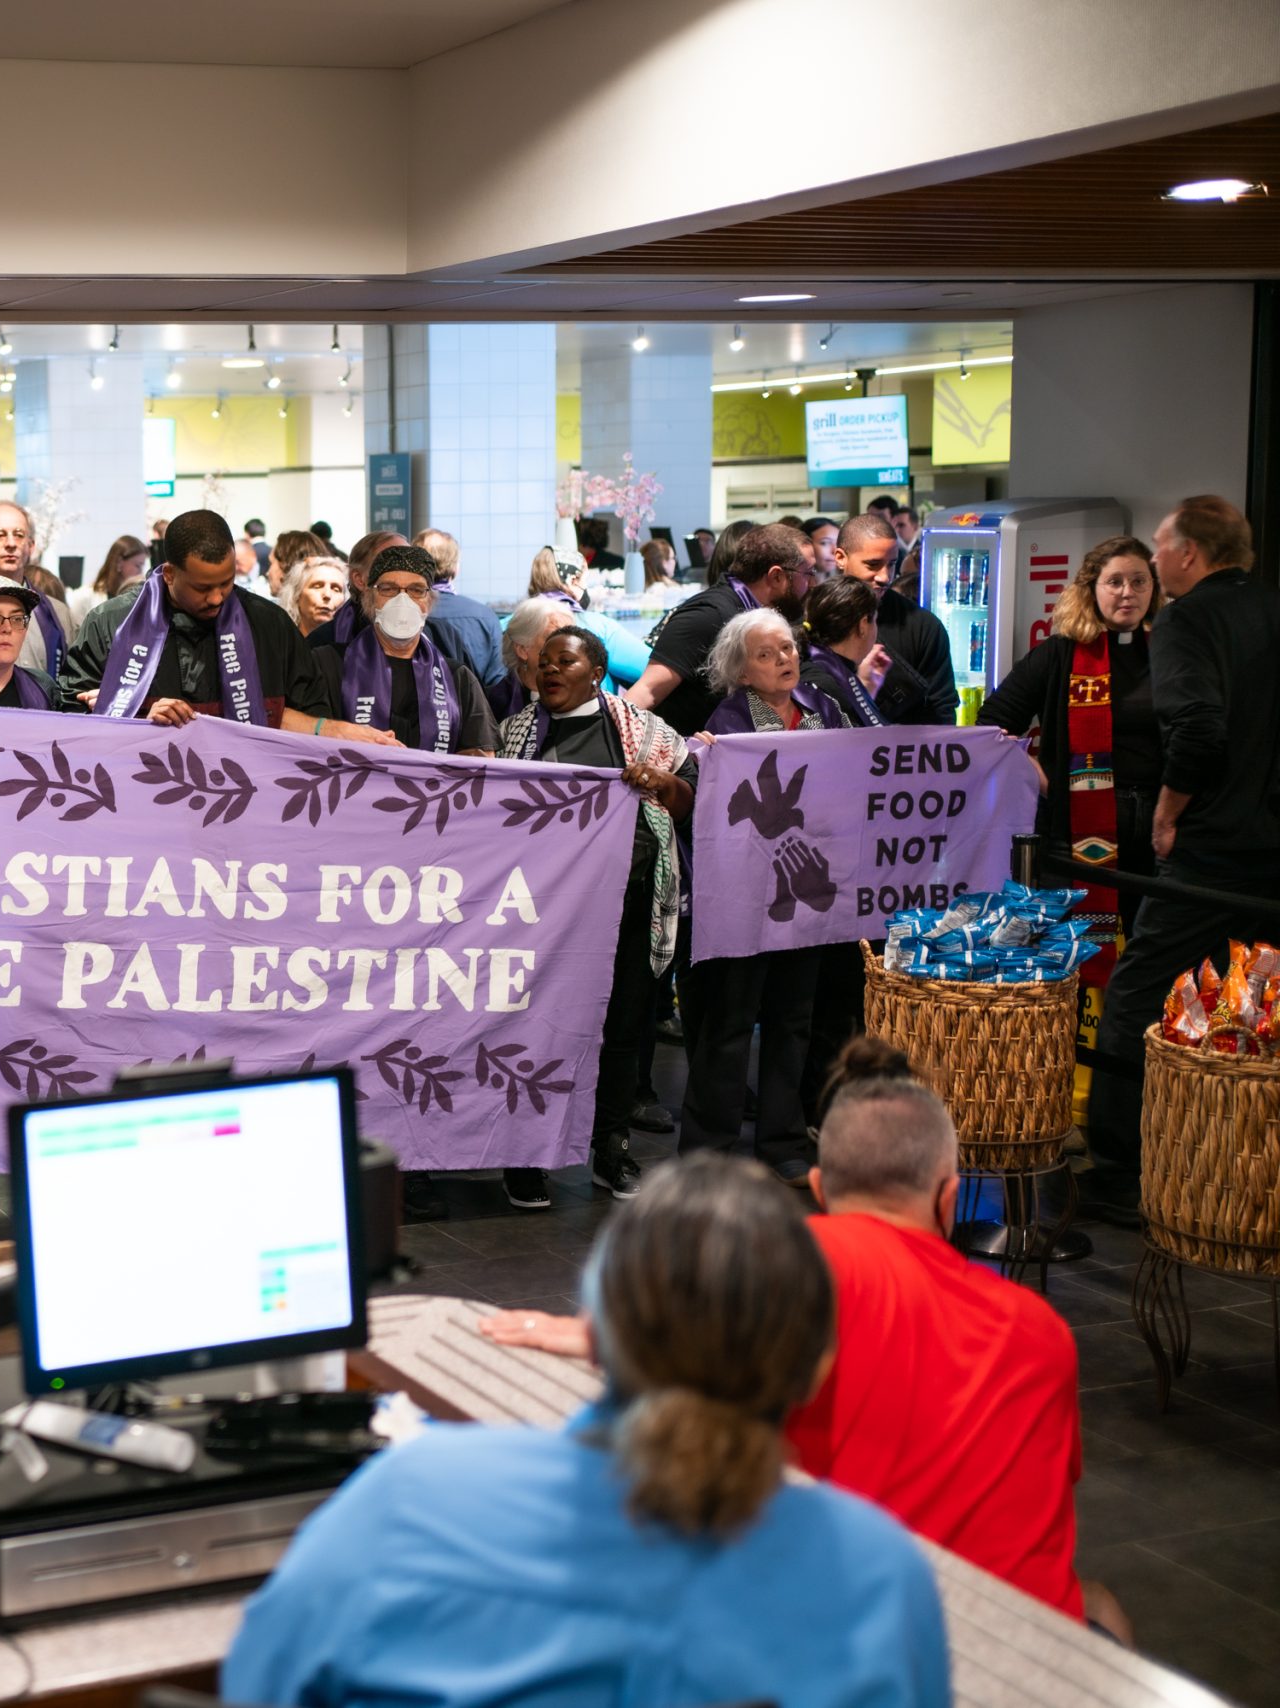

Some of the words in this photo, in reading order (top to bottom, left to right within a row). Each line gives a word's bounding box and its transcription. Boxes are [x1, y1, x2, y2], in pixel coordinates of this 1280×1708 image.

[813, 413, 836, 431] grill
[867, 411, 900, 423] PICKUP
[120, 658, 143, 686] for
[132, 644, 148, 657] a
[220, 633, 241, 674] Free
[433, 666, 442, 678] a
[433, 680, 447, 706] for
[354, 696, 376, 725] Fre
[869, 743, 970, 777] SEND
[867, 789, 966, 821] FOOD
[875, 834, 948, 867] NOT
[316, 863, 465, 925] FOR
[486, 865, 541, 925] A
[57, 941, 536, 1012] PALESTINE
